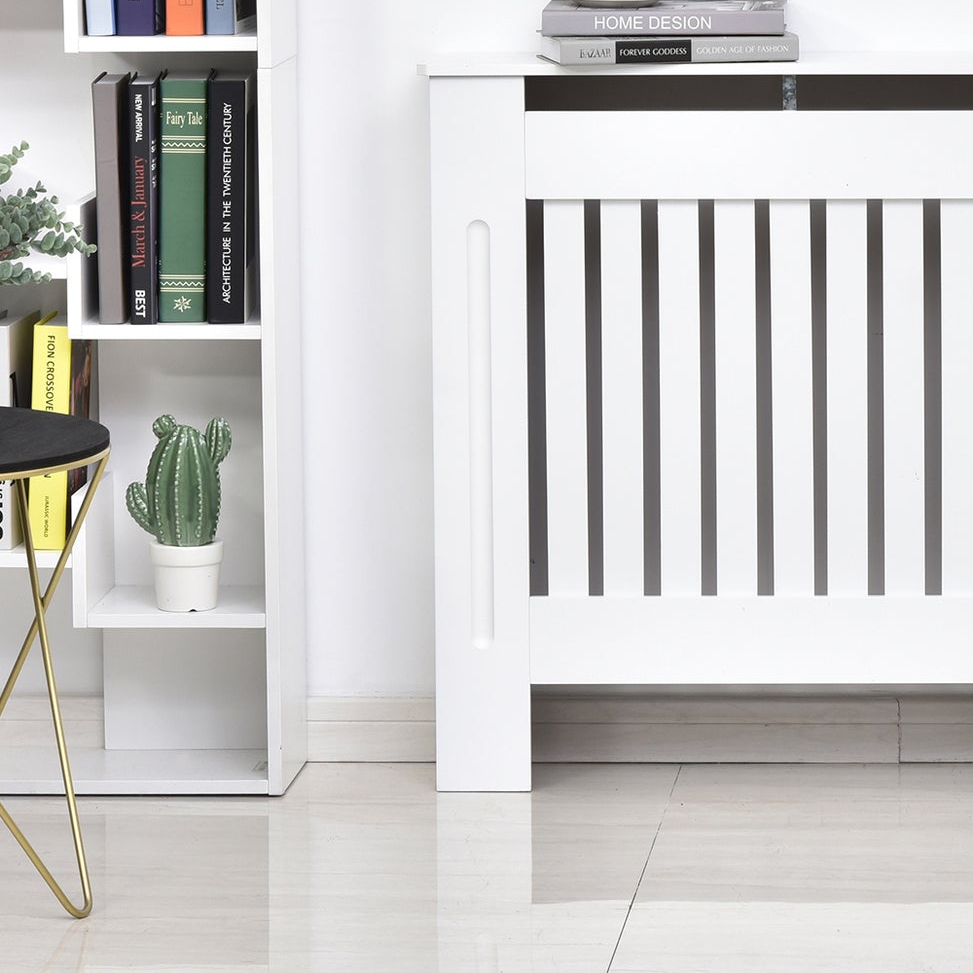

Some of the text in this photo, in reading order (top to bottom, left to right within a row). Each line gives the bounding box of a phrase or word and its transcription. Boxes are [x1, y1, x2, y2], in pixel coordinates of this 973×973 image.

[594, 16, 644, 29] HOME
[619, 47, 687, 57] FOREVER GODDESS
[696, 46, 727, 55] GOLDEN
[745, 45, 755, 53] OF
[757, 44, 790, 53] FASHION
[134, 94, 143, 143] NEW ARRIVAL
[166, 111, 203, 129] Fairy Tale
[131, 156, 147, 268] March & January
[222, 102, 232, 304] ARCHITECTURE IN THE TWENTIETH CENTURY
[135, 289, 146, 318] BEST
[46, 335, 55, 412] FION CROSSOVE
